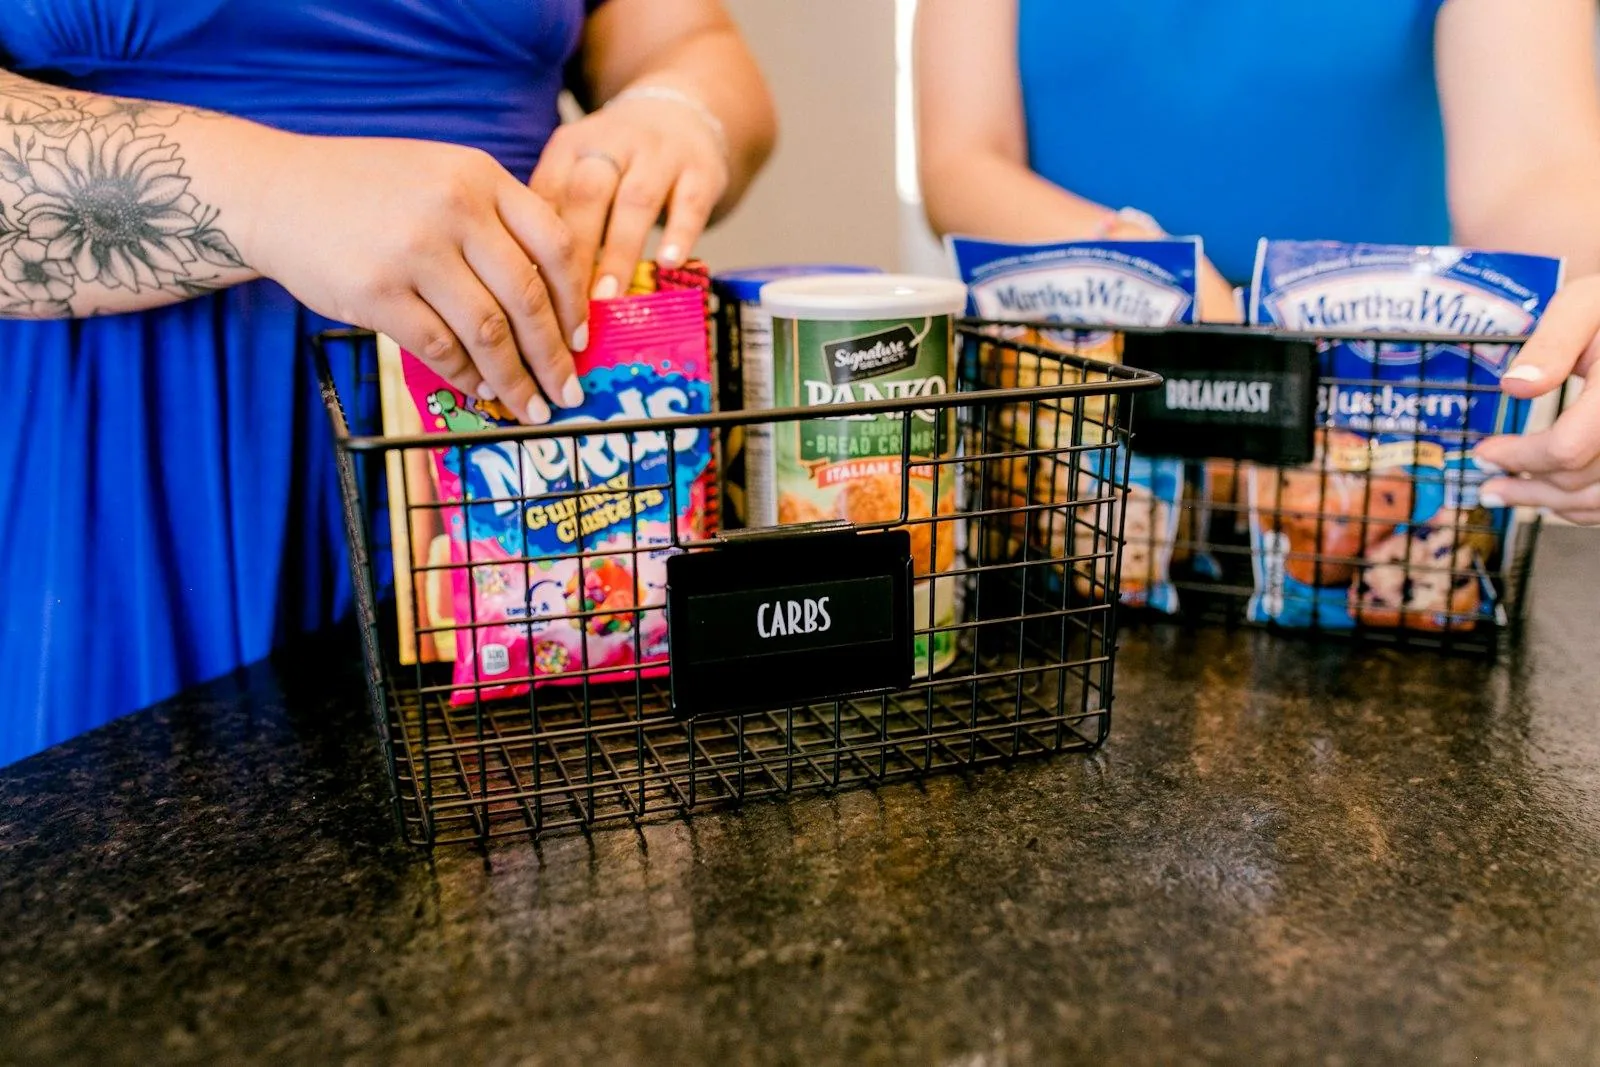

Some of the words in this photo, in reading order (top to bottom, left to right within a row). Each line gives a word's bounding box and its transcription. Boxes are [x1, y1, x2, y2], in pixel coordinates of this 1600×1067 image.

[1299, 294, 1414, 331] Martha
[834, 340, 906, 371] Signature
[804, 375, 946, 422] PANKO
[1165, 378, 1272, 413] BREAKFAST
[816, 434, 871, 454] BREAD
[826, 461, 889, 481] ITALIAN
[757, 597, 831, 638] CARBS
